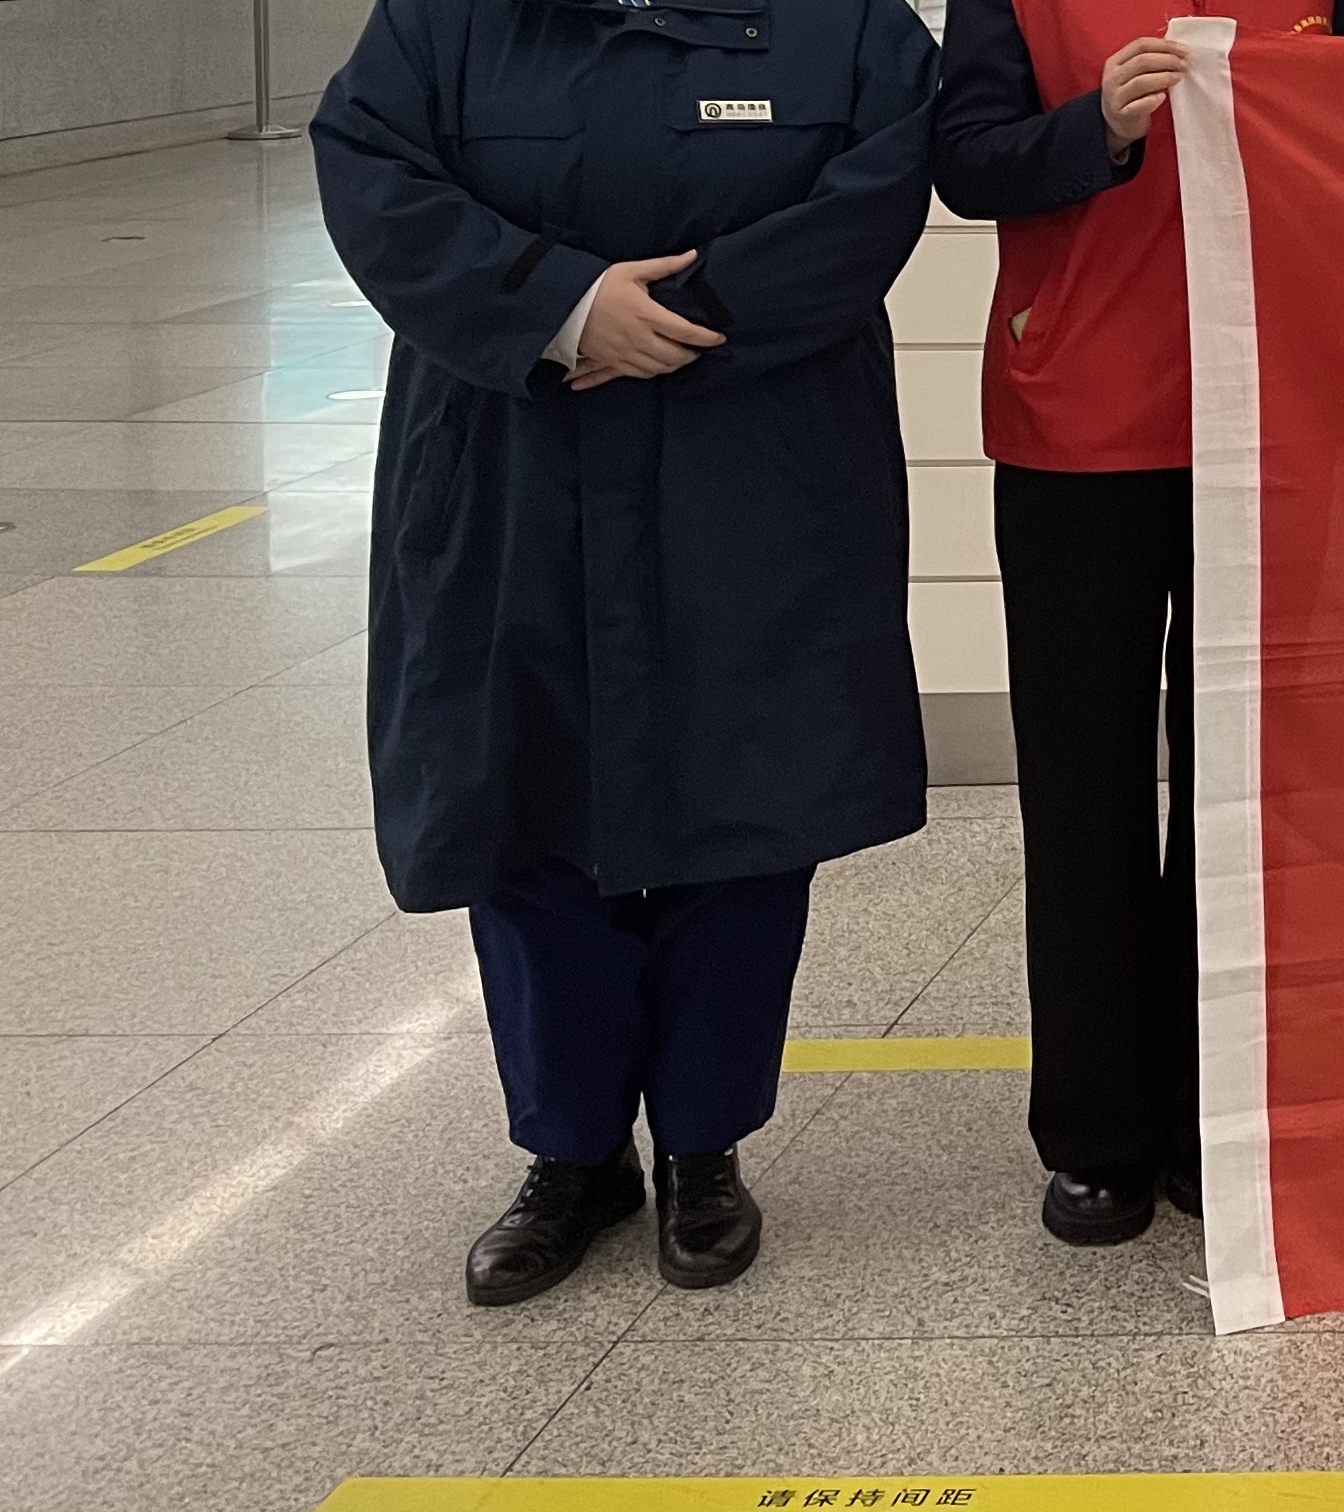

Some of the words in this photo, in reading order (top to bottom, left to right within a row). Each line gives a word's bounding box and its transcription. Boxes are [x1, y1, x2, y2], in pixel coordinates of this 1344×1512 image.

[757, 1488, 978, 1508] 请保持间距
